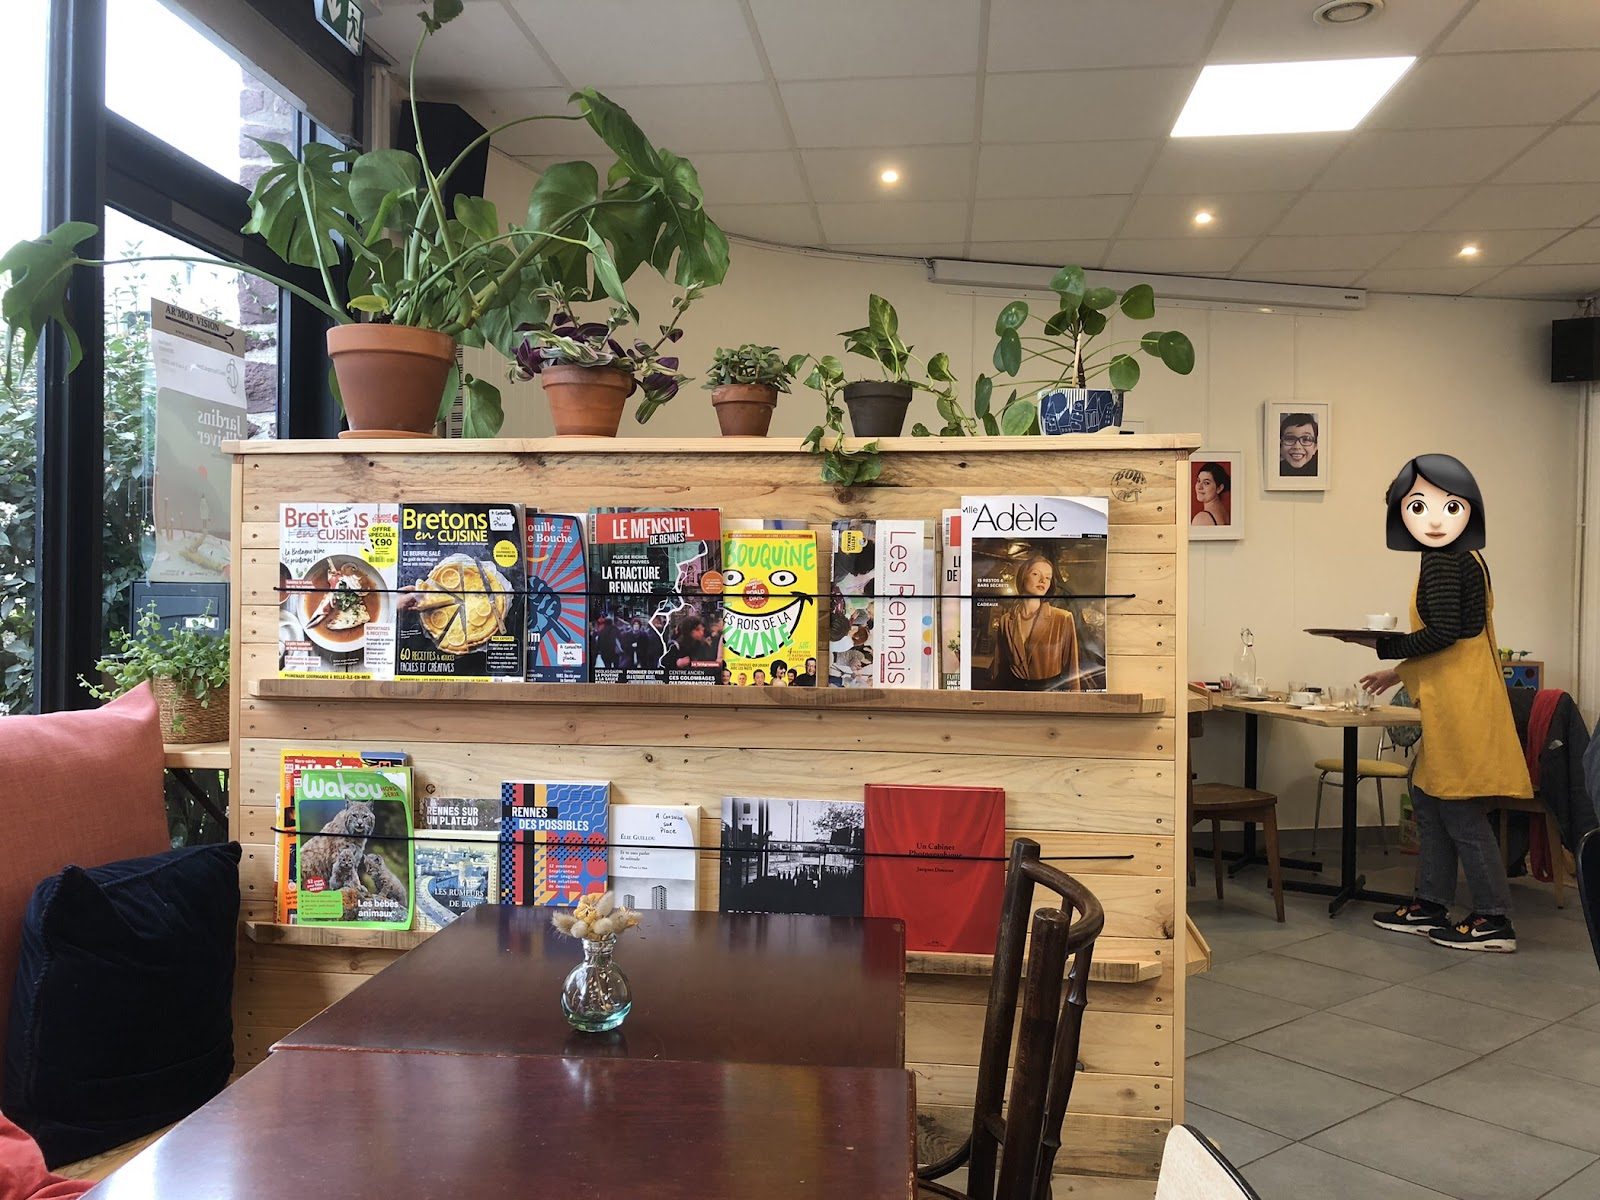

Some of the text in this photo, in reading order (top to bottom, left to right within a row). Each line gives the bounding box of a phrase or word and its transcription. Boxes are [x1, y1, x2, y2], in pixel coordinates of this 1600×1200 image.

[196, 316, 220, 332] VISION
[402, 508, 488, 530] Bretons
[972, 503, 1058, 531] Adèle
[612, 518, 628, 540] LE
[630, 516, 695, 539] MENSUEL
[317, 529, 366, 541] CUISINE
[414, 530, 488, 542] en CUISINE
[536, 532, 573, 543] Bouche
[650, 532, 685, 545] DE RENNES
[601, 566, 660, 579] LA FRACTURE
[947, 570, 957, 581] DE
[609, 580, 653, 594] RENNAISE
[887, 531, 916, 684] Les Rennais
[737, 617, 760, 631] ROIS
[762, 616, 776, 631] DE
[778, 611, 792, 626] LA
[400, 647, 411, 660] 60
[411, 650, 436, 661] RECETTES
[400, 662, 418, 672] FACILES
[419, 662, 426, 672] ET
[427, 806, 479, 816] RENNES SUR
[511, 806, 548, 818] RENNES
[427, 816, 479, 827] UN PLATEAU
[519, 819, 589, 832] DES POSSIBLES
[916, 842, 955, 850] Un Cabinet
[434, 888, 484, 898] LES RUMEURS
[357, 898, 399, 908] Les bébés
[449, 900, 460, 908] DE
[357, 909, 392, 918] animaux
